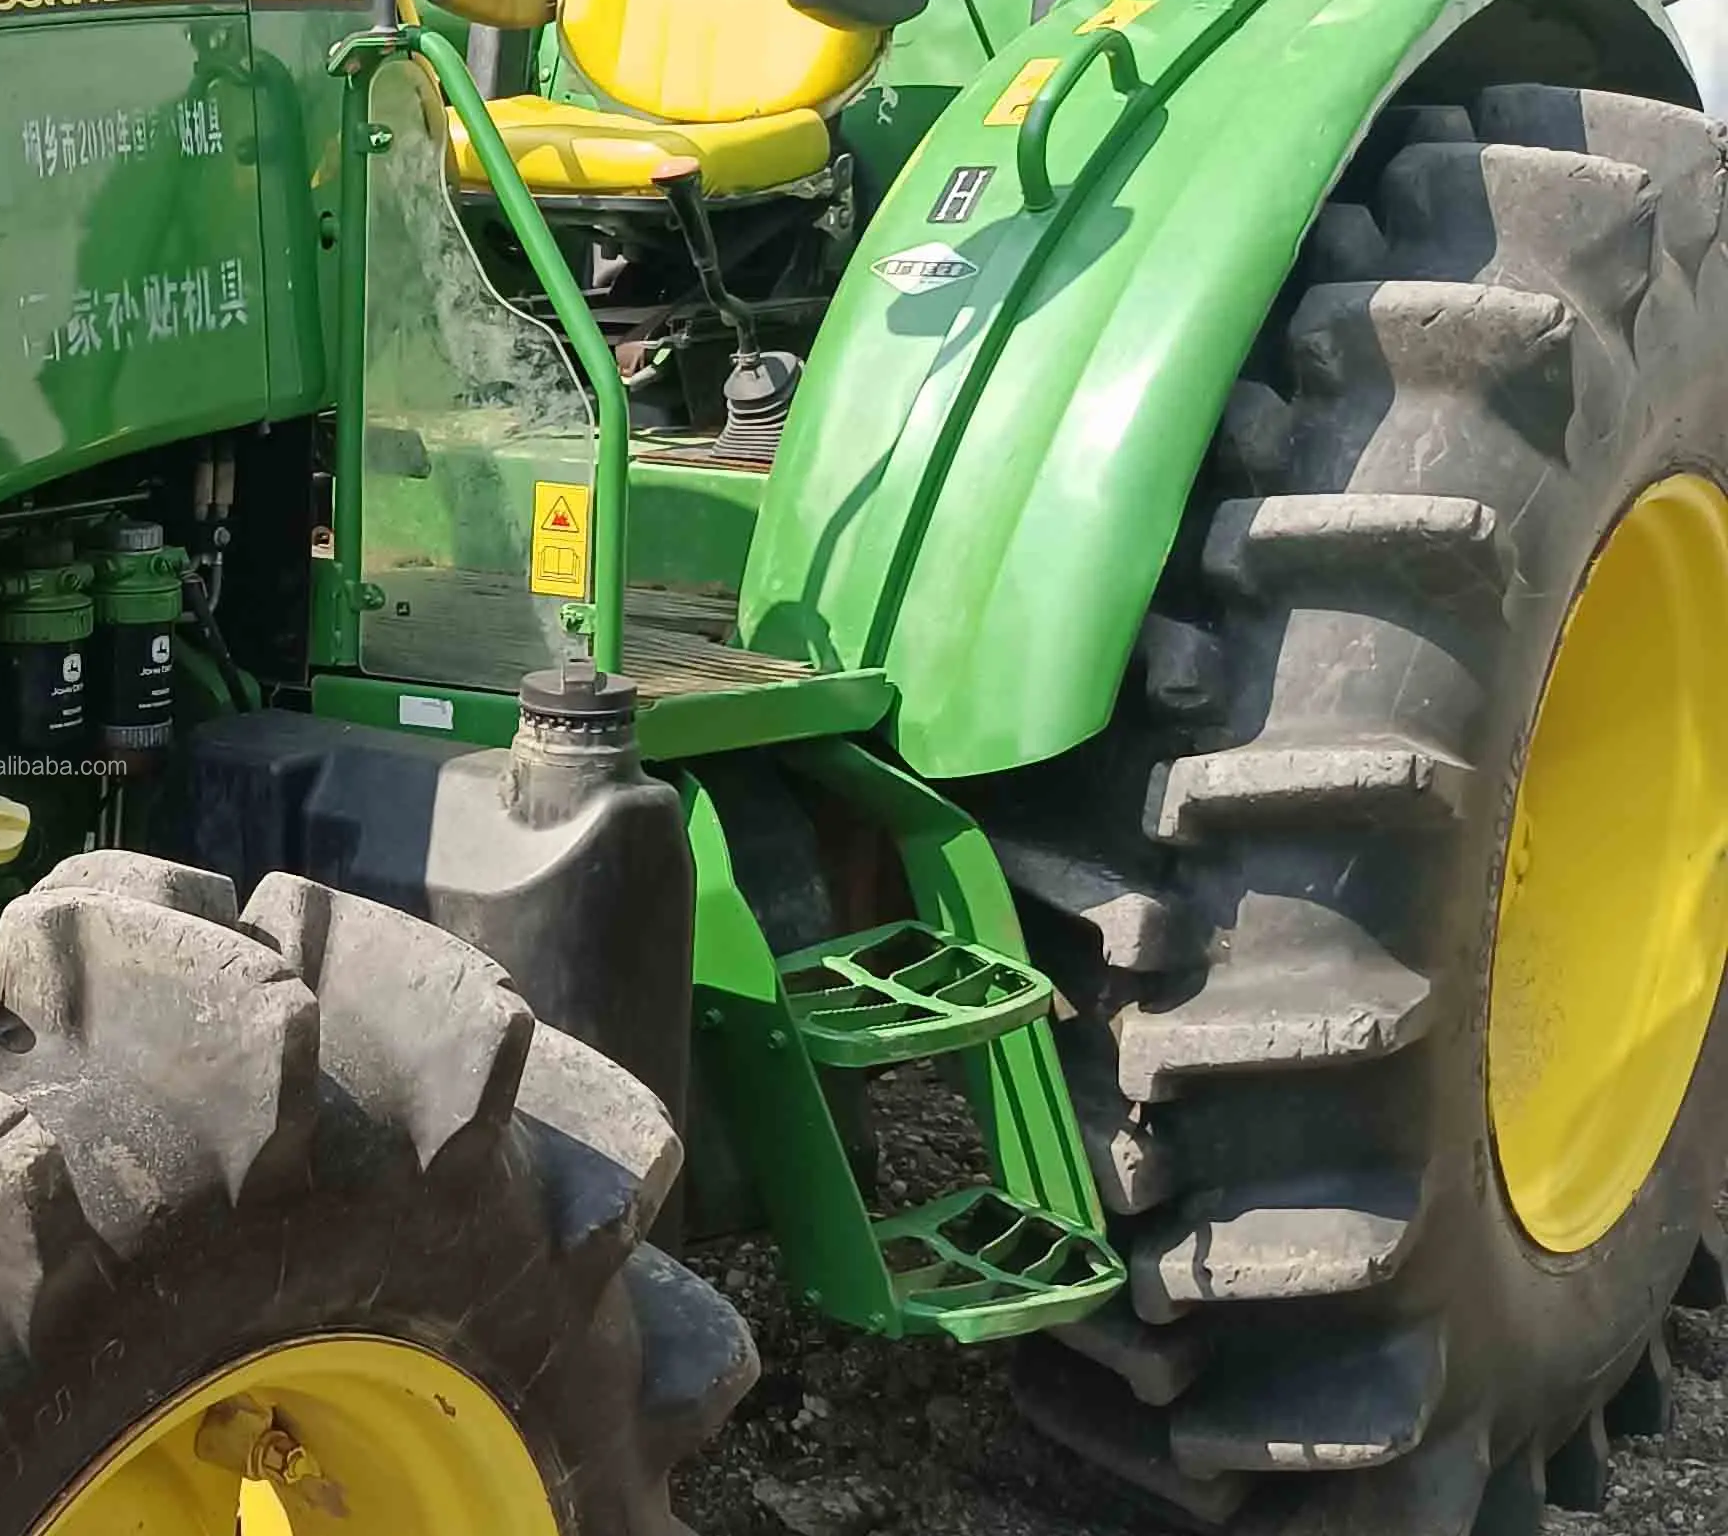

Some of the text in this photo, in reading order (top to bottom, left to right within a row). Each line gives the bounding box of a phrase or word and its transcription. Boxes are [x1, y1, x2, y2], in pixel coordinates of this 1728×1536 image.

[22, 98, 223, 178] 桐乡市2019年国贴机具
[935, 169, 989, 221] H
